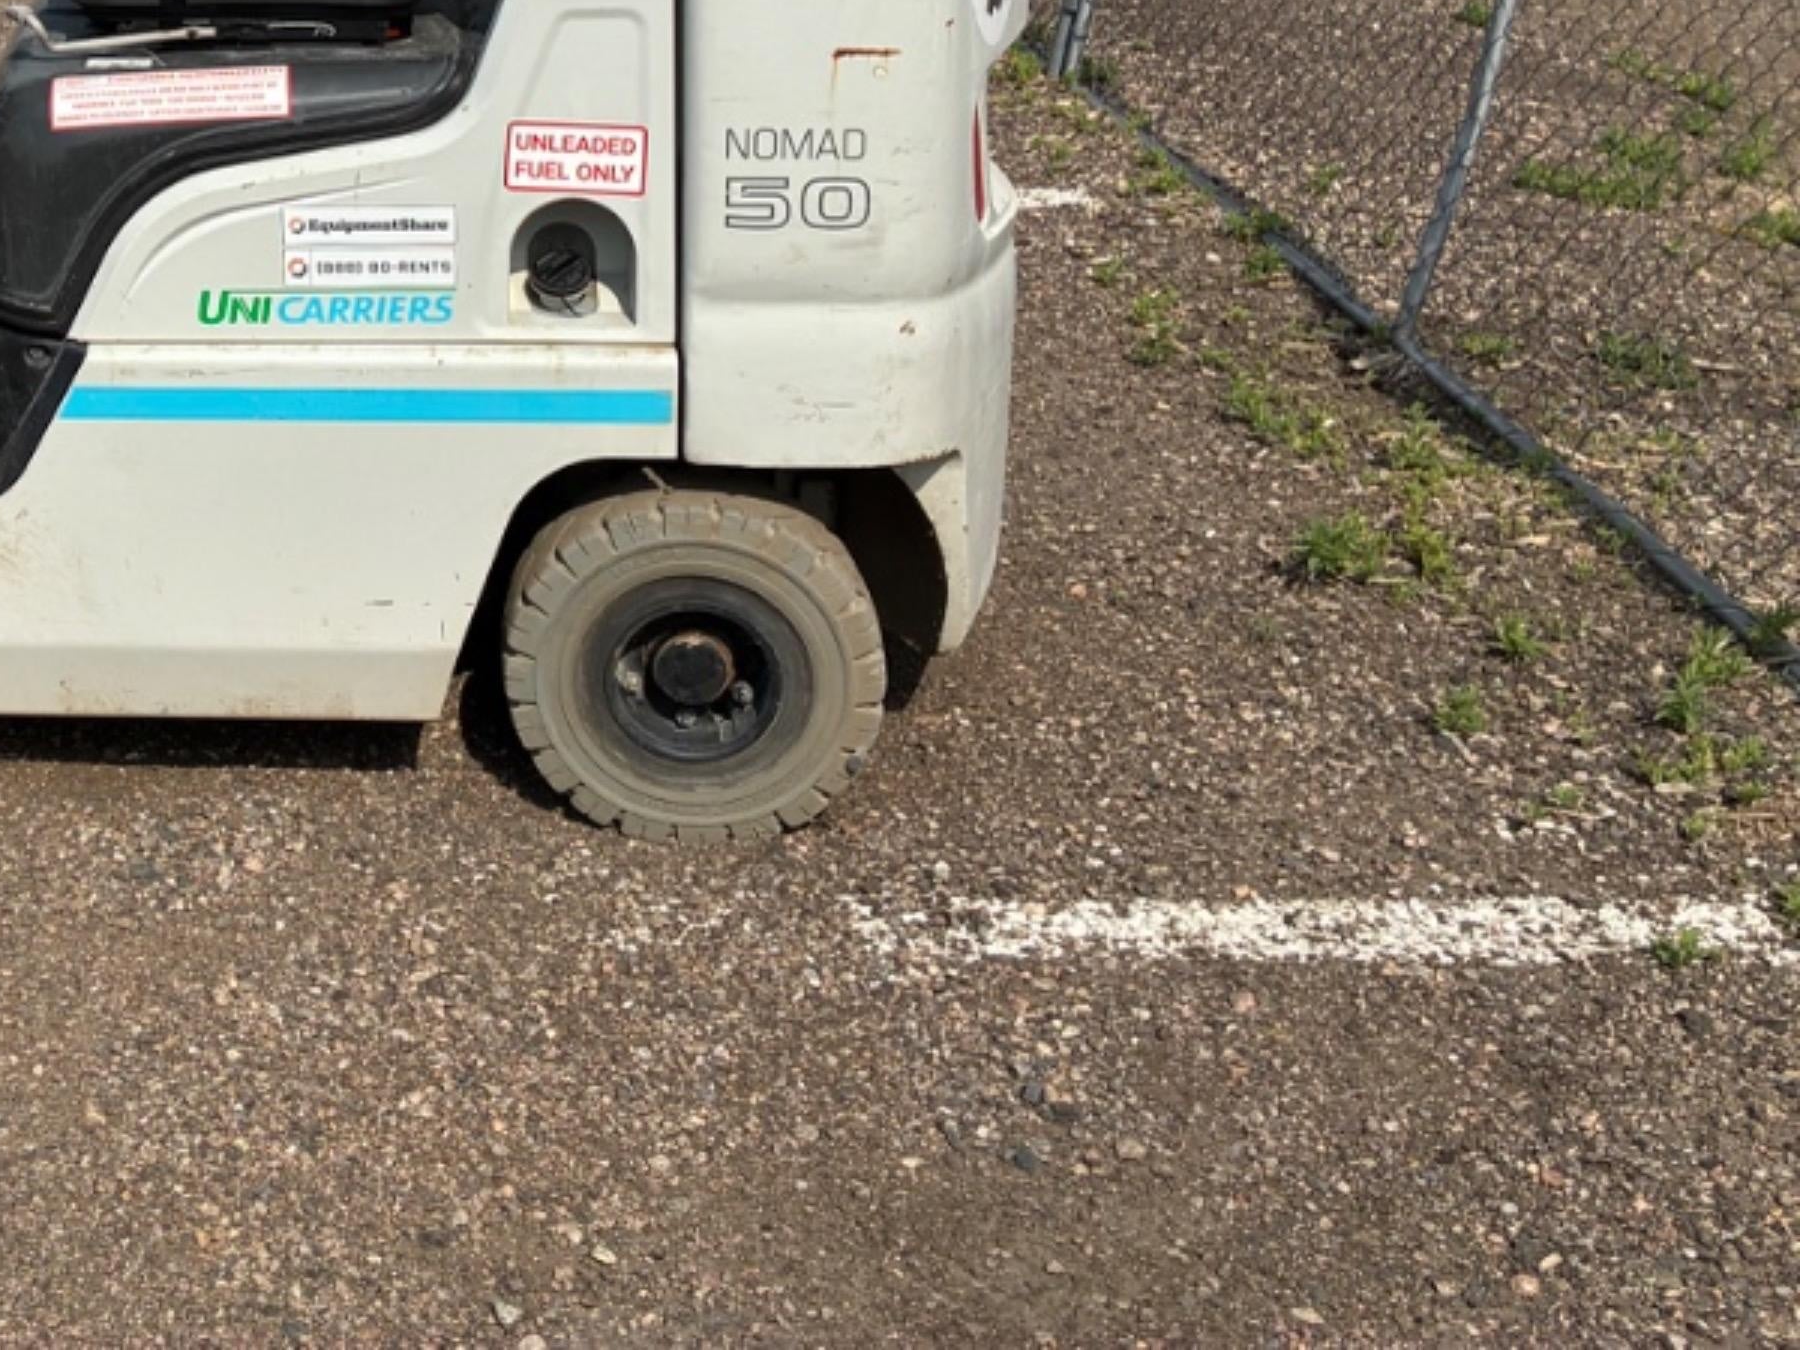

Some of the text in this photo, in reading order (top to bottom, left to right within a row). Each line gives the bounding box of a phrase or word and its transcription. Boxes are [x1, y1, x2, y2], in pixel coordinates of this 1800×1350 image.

[515, 132, 637, 156] UNLEADED
[725, 127, 867, 160] NOMAD
[515, 160, 635, 183] FUEL ONLY
[725, 176, 871, 230] 50
[308, 217, 449, 234] EquipmentShare
